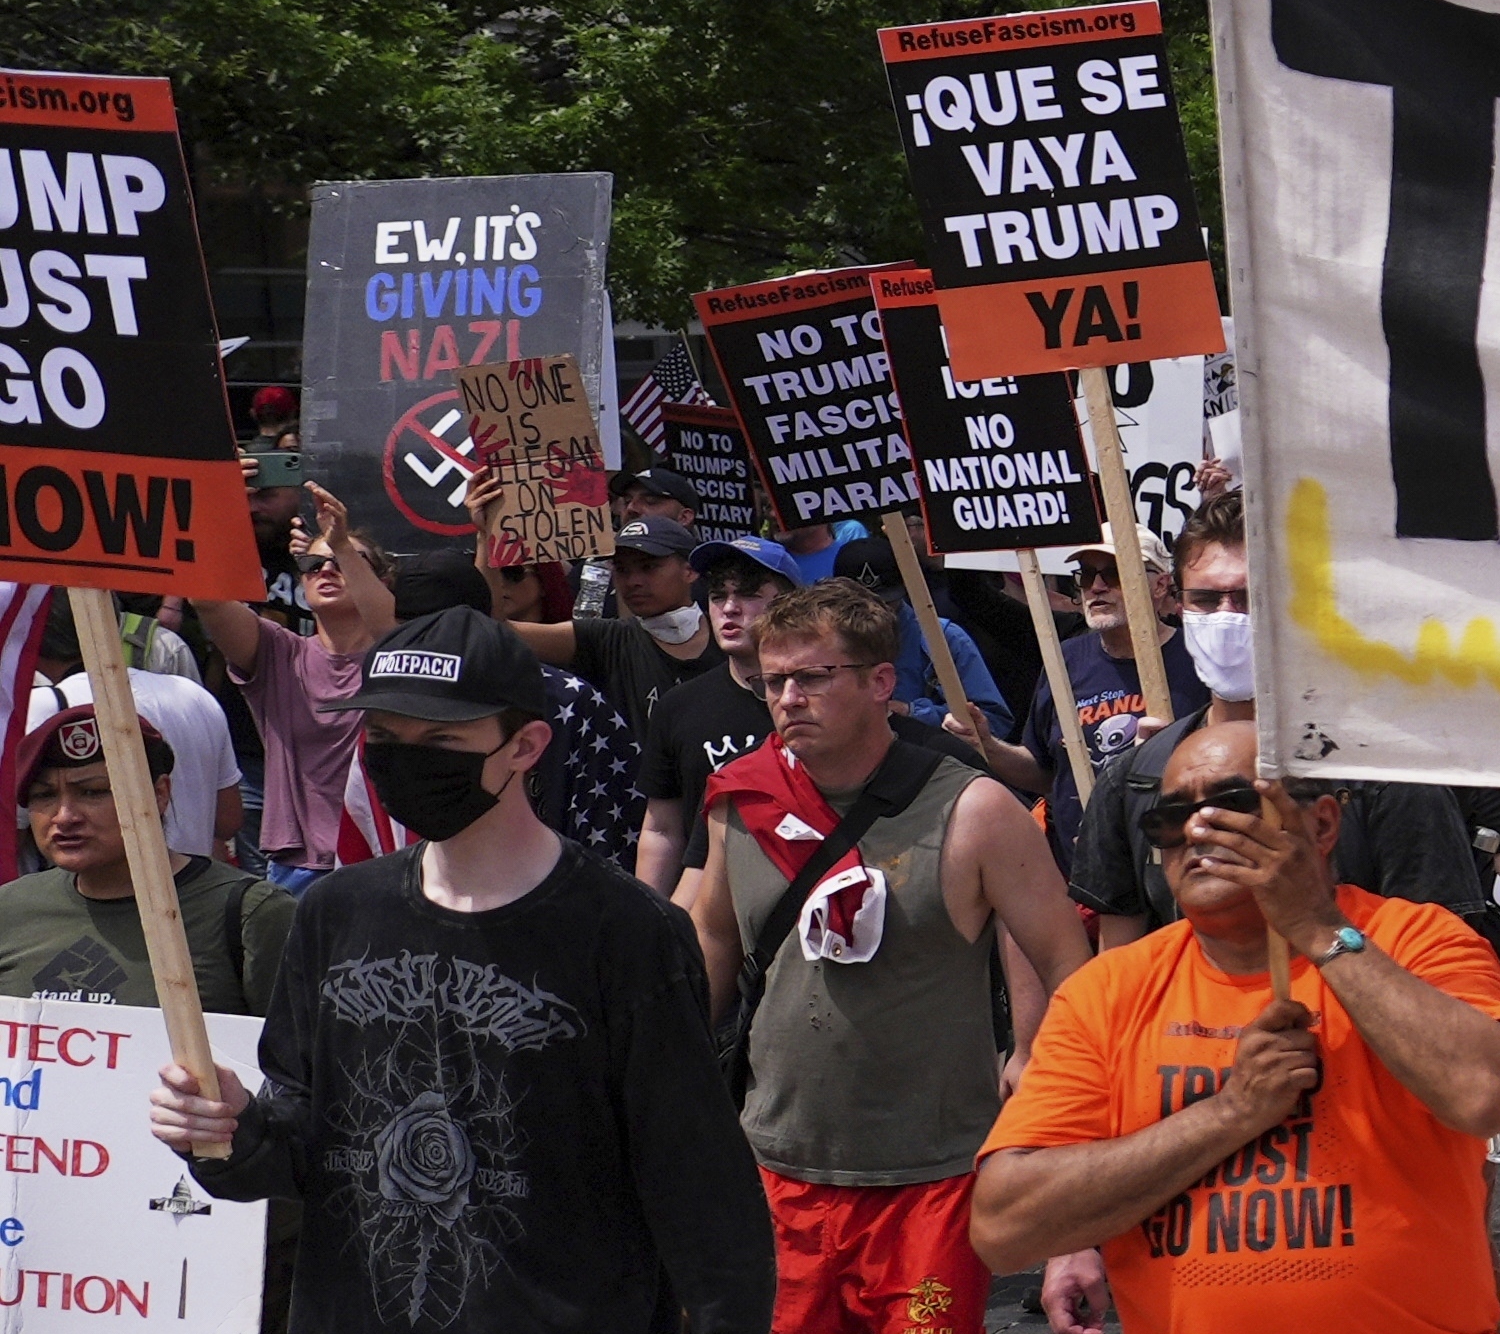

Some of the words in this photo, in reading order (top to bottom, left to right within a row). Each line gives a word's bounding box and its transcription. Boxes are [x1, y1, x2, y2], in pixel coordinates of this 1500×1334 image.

[897, 11, 1136, 53] RefuseFascism.org
[905, 66, 1063, 147] ¡QUE
[1077, 54, 1166, 115] SE
[960, 130, 1137, 197] VAYA
[375, 217, 466, 266] EW,
[473, 204, 542, 261] IT'S
[944, 194, 1180, 268] TRUMP
[365, 264, 542, 322] GIVING
[756, 324, 822, 362] NO
[830, 310, 884, 347] TO
[1024, 280, 1141, 350] YA!
[380, 320, 521, 382] NAZI
[460, 373, 508, 414] NO
[516, 363, 575, 409] ONE
[506, 412, 541, 447] IS
[680, 430, 703, 450] NO
[708, 433, 733, 453] TO
[965, 413, 1014, 451] NO
[672, 452, 747, 478] TRUMP'S
[924, 450, 1082, 492] NATIONAL
[0, 464, 195, 563] OW!
[518, 482, 556, 515] ON
[952, 491, 1070, 531] GUARD!
[501, 507, 605, 544] STOLEN
[376, 654, 454, 677] WOLFPACK
[1075, 694, 1098, 709] Next
[31, 989, 82, 1003] stand
[88, 992, 116, 1006] up,
[0, 1134, 109, 1177] END
[1193, 1122, 1313, 1191] UST
[1207, 1183, 1355, 1255] NOW!
